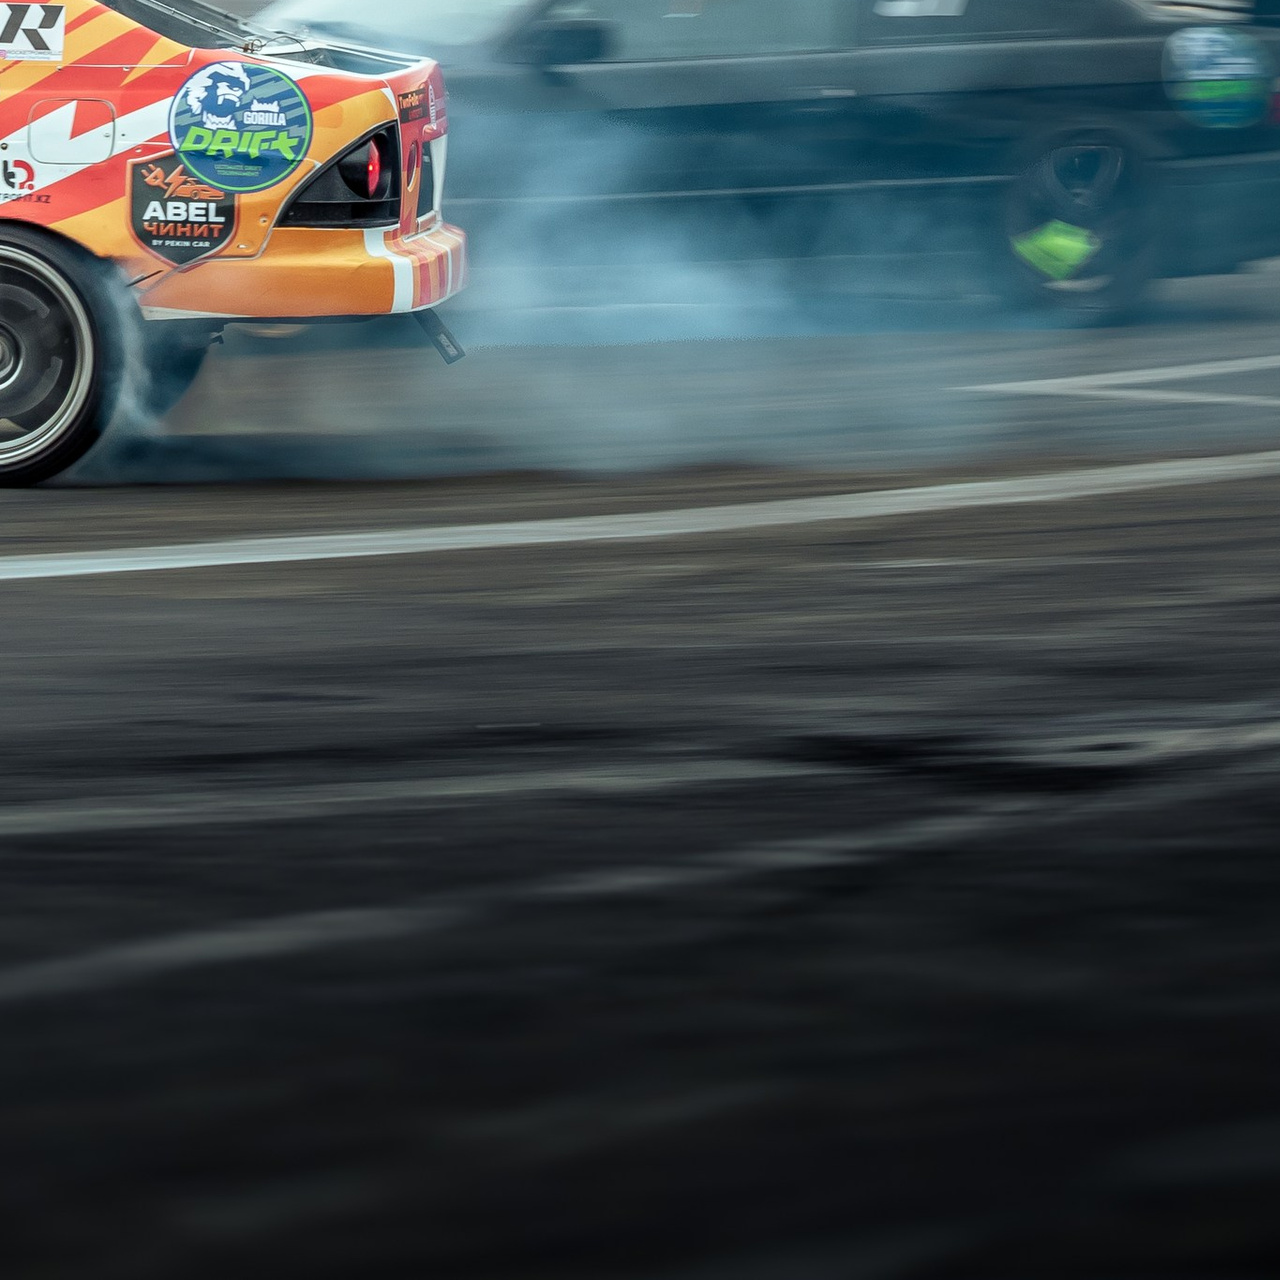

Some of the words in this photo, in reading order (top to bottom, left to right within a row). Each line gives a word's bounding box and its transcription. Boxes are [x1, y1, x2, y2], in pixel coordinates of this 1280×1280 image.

[243, 111, 287, 126] GORILLA
[179, 126, 299, 161] DRIFT
[142, 200, 226, 222] ABEL
[143, 222, 224, 237] ЧИНИТ
